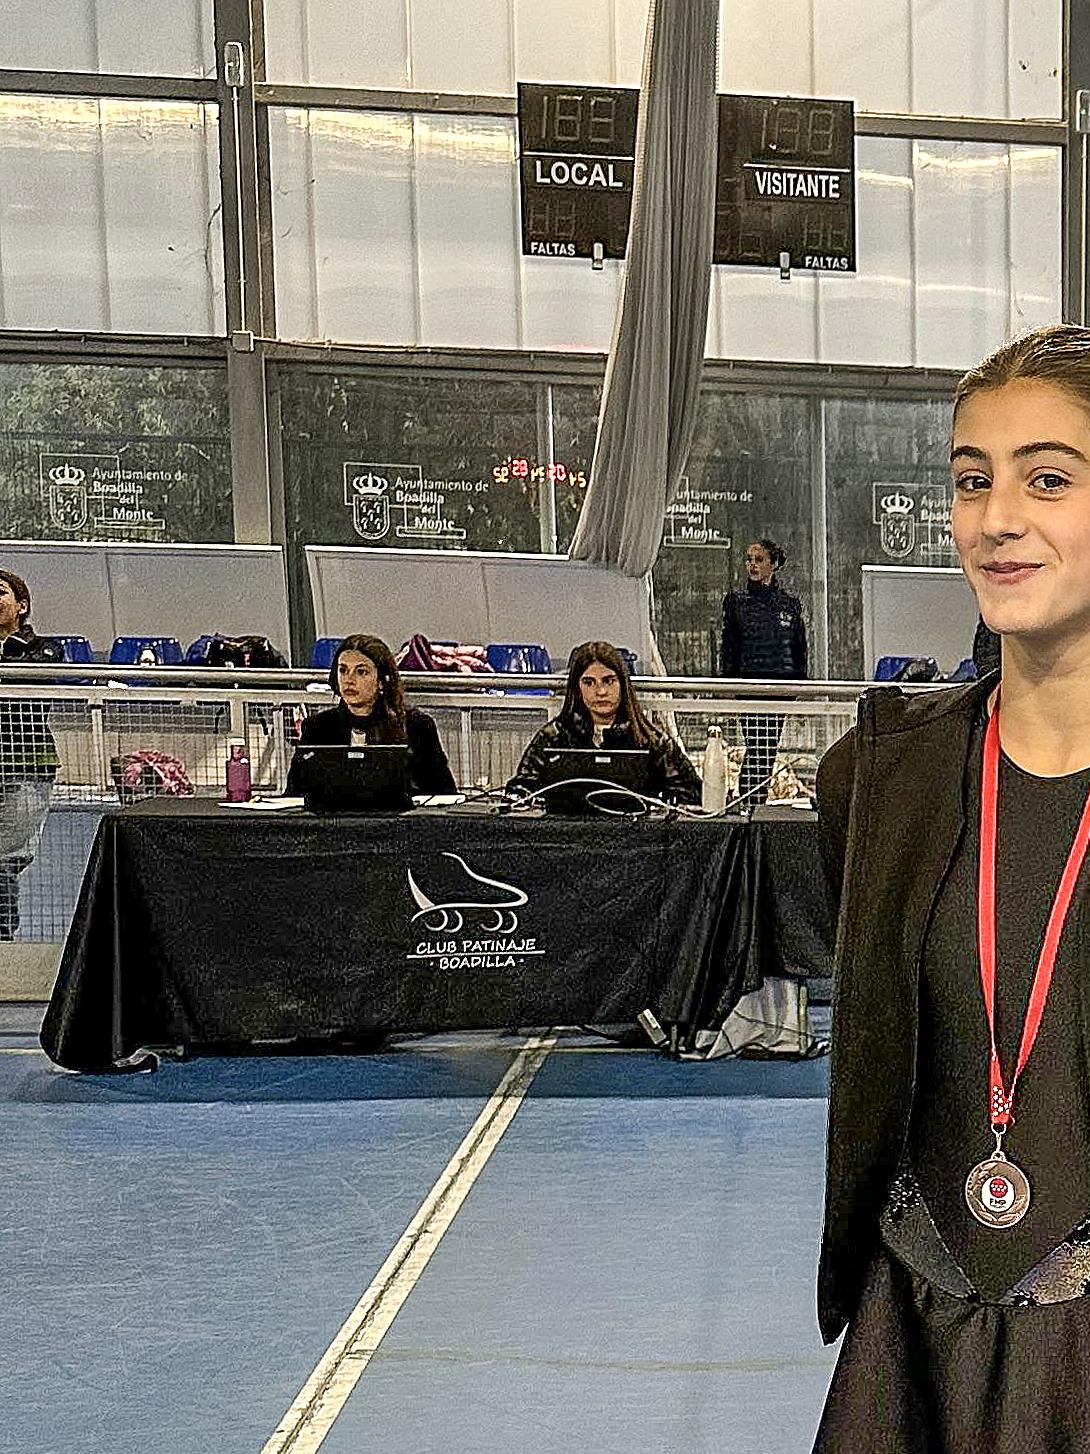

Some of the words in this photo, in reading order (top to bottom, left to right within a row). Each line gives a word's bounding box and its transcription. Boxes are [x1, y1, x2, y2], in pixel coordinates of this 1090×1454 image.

[535, 160, 624, 188] LOCAL
[755, 171, 840, 199] VISITANTE
[531, 242, 576, 256] FALTAS
[805, 255, 848, 270] FALTAS
[91, 467, 172, 482] Ayuntamiento
[93, 481, 144, 494] Boadilla
[394, 477, 473, 492] Ayuntamiento
[475, 480, 489, 492] de
[396, 490, 445, 504] Boadilla
[676, 490, 737, 501] untamiento
[740, 490, 753, 502] de
[112, 507, 154, 520] Monte
[414, 516, 455, 529] Monte
[681, 526, 720, 539] Monte
[416, 941, 457, 954] CLUB
[463, 938, 537, 952] PATINAJE
[440, 956, 516, 970] BOADILLA
